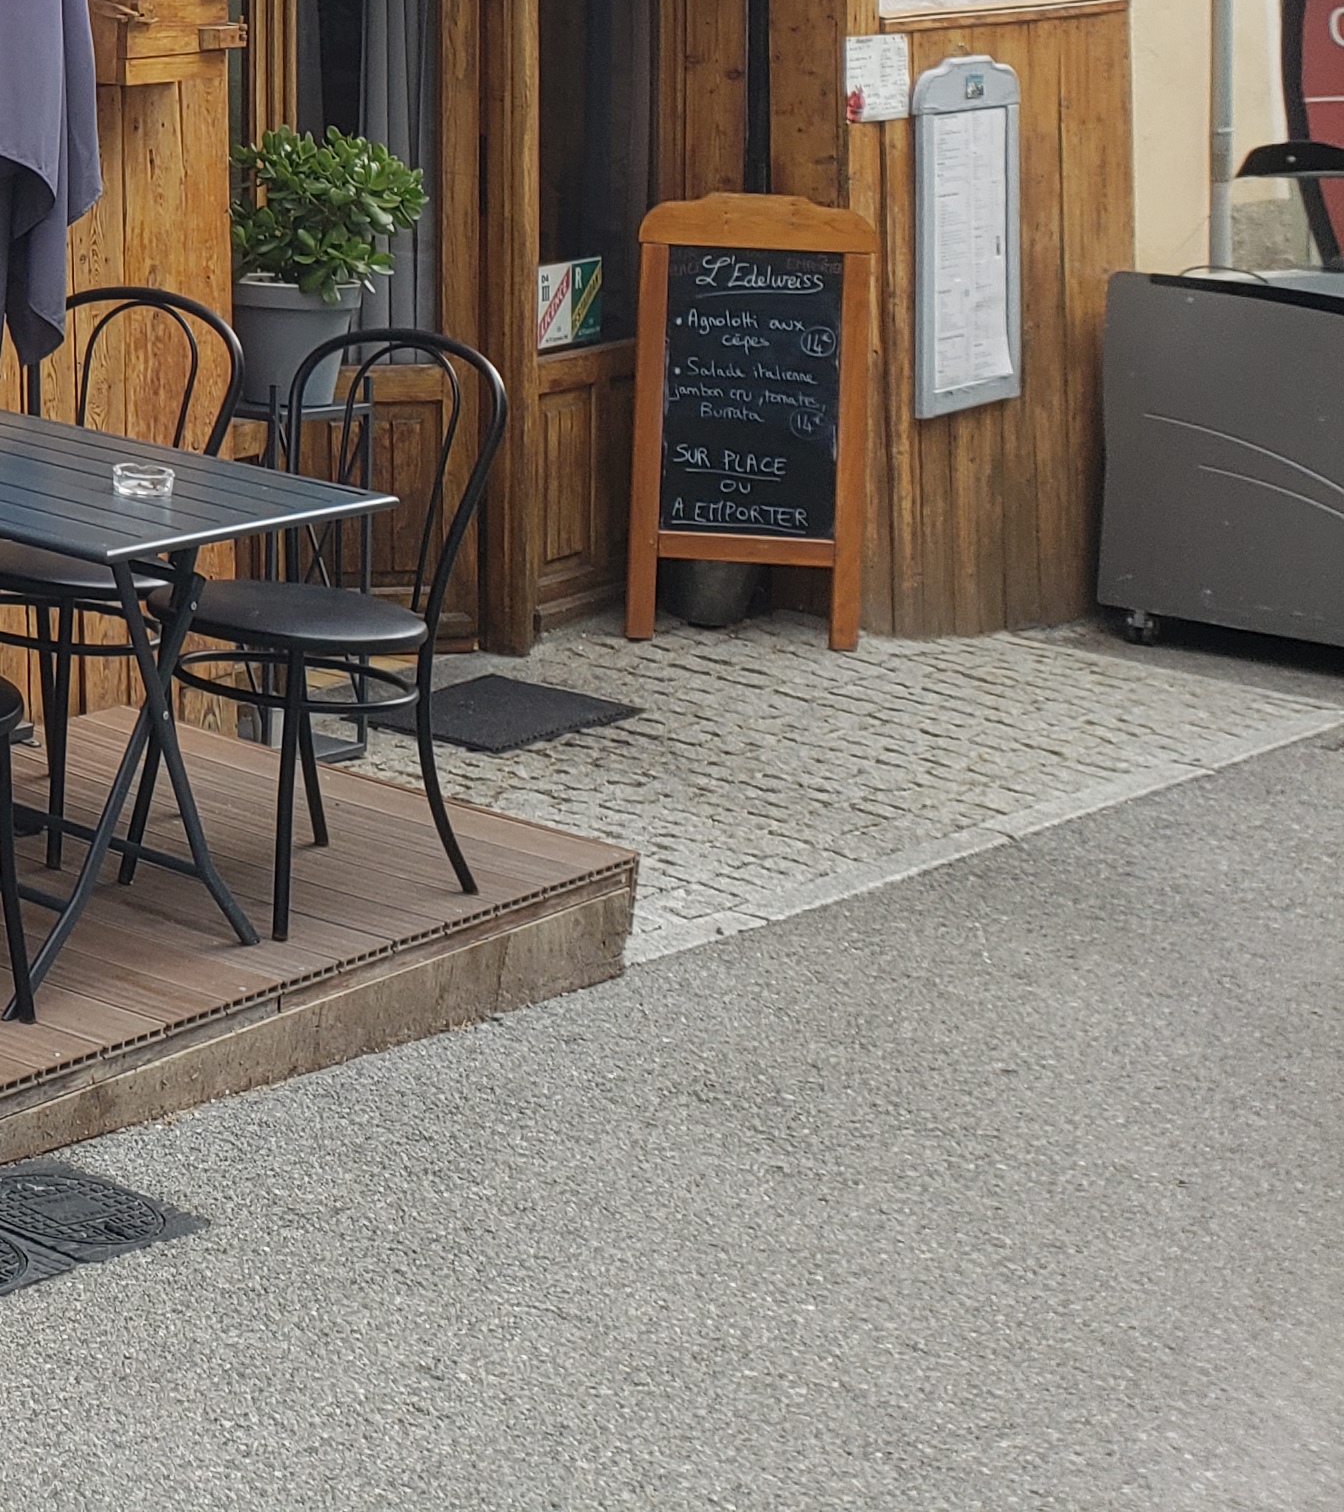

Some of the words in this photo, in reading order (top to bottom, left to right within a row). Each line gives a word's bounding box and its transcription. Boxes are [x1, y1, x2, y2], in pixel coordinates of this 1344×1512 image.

[695, 255, 824, 288] L'Edelweiss
[769, 319, 806, 331] aux
[687, 357, 746, 378] Salade
[669, 383, 724, 400] jambon
[673, 443, 711, 468] SUR
[723, 449, 787, 475] PLACE
[720, 479, 751, 494] OU
[695, 499, 809, 527] EMPORTER
